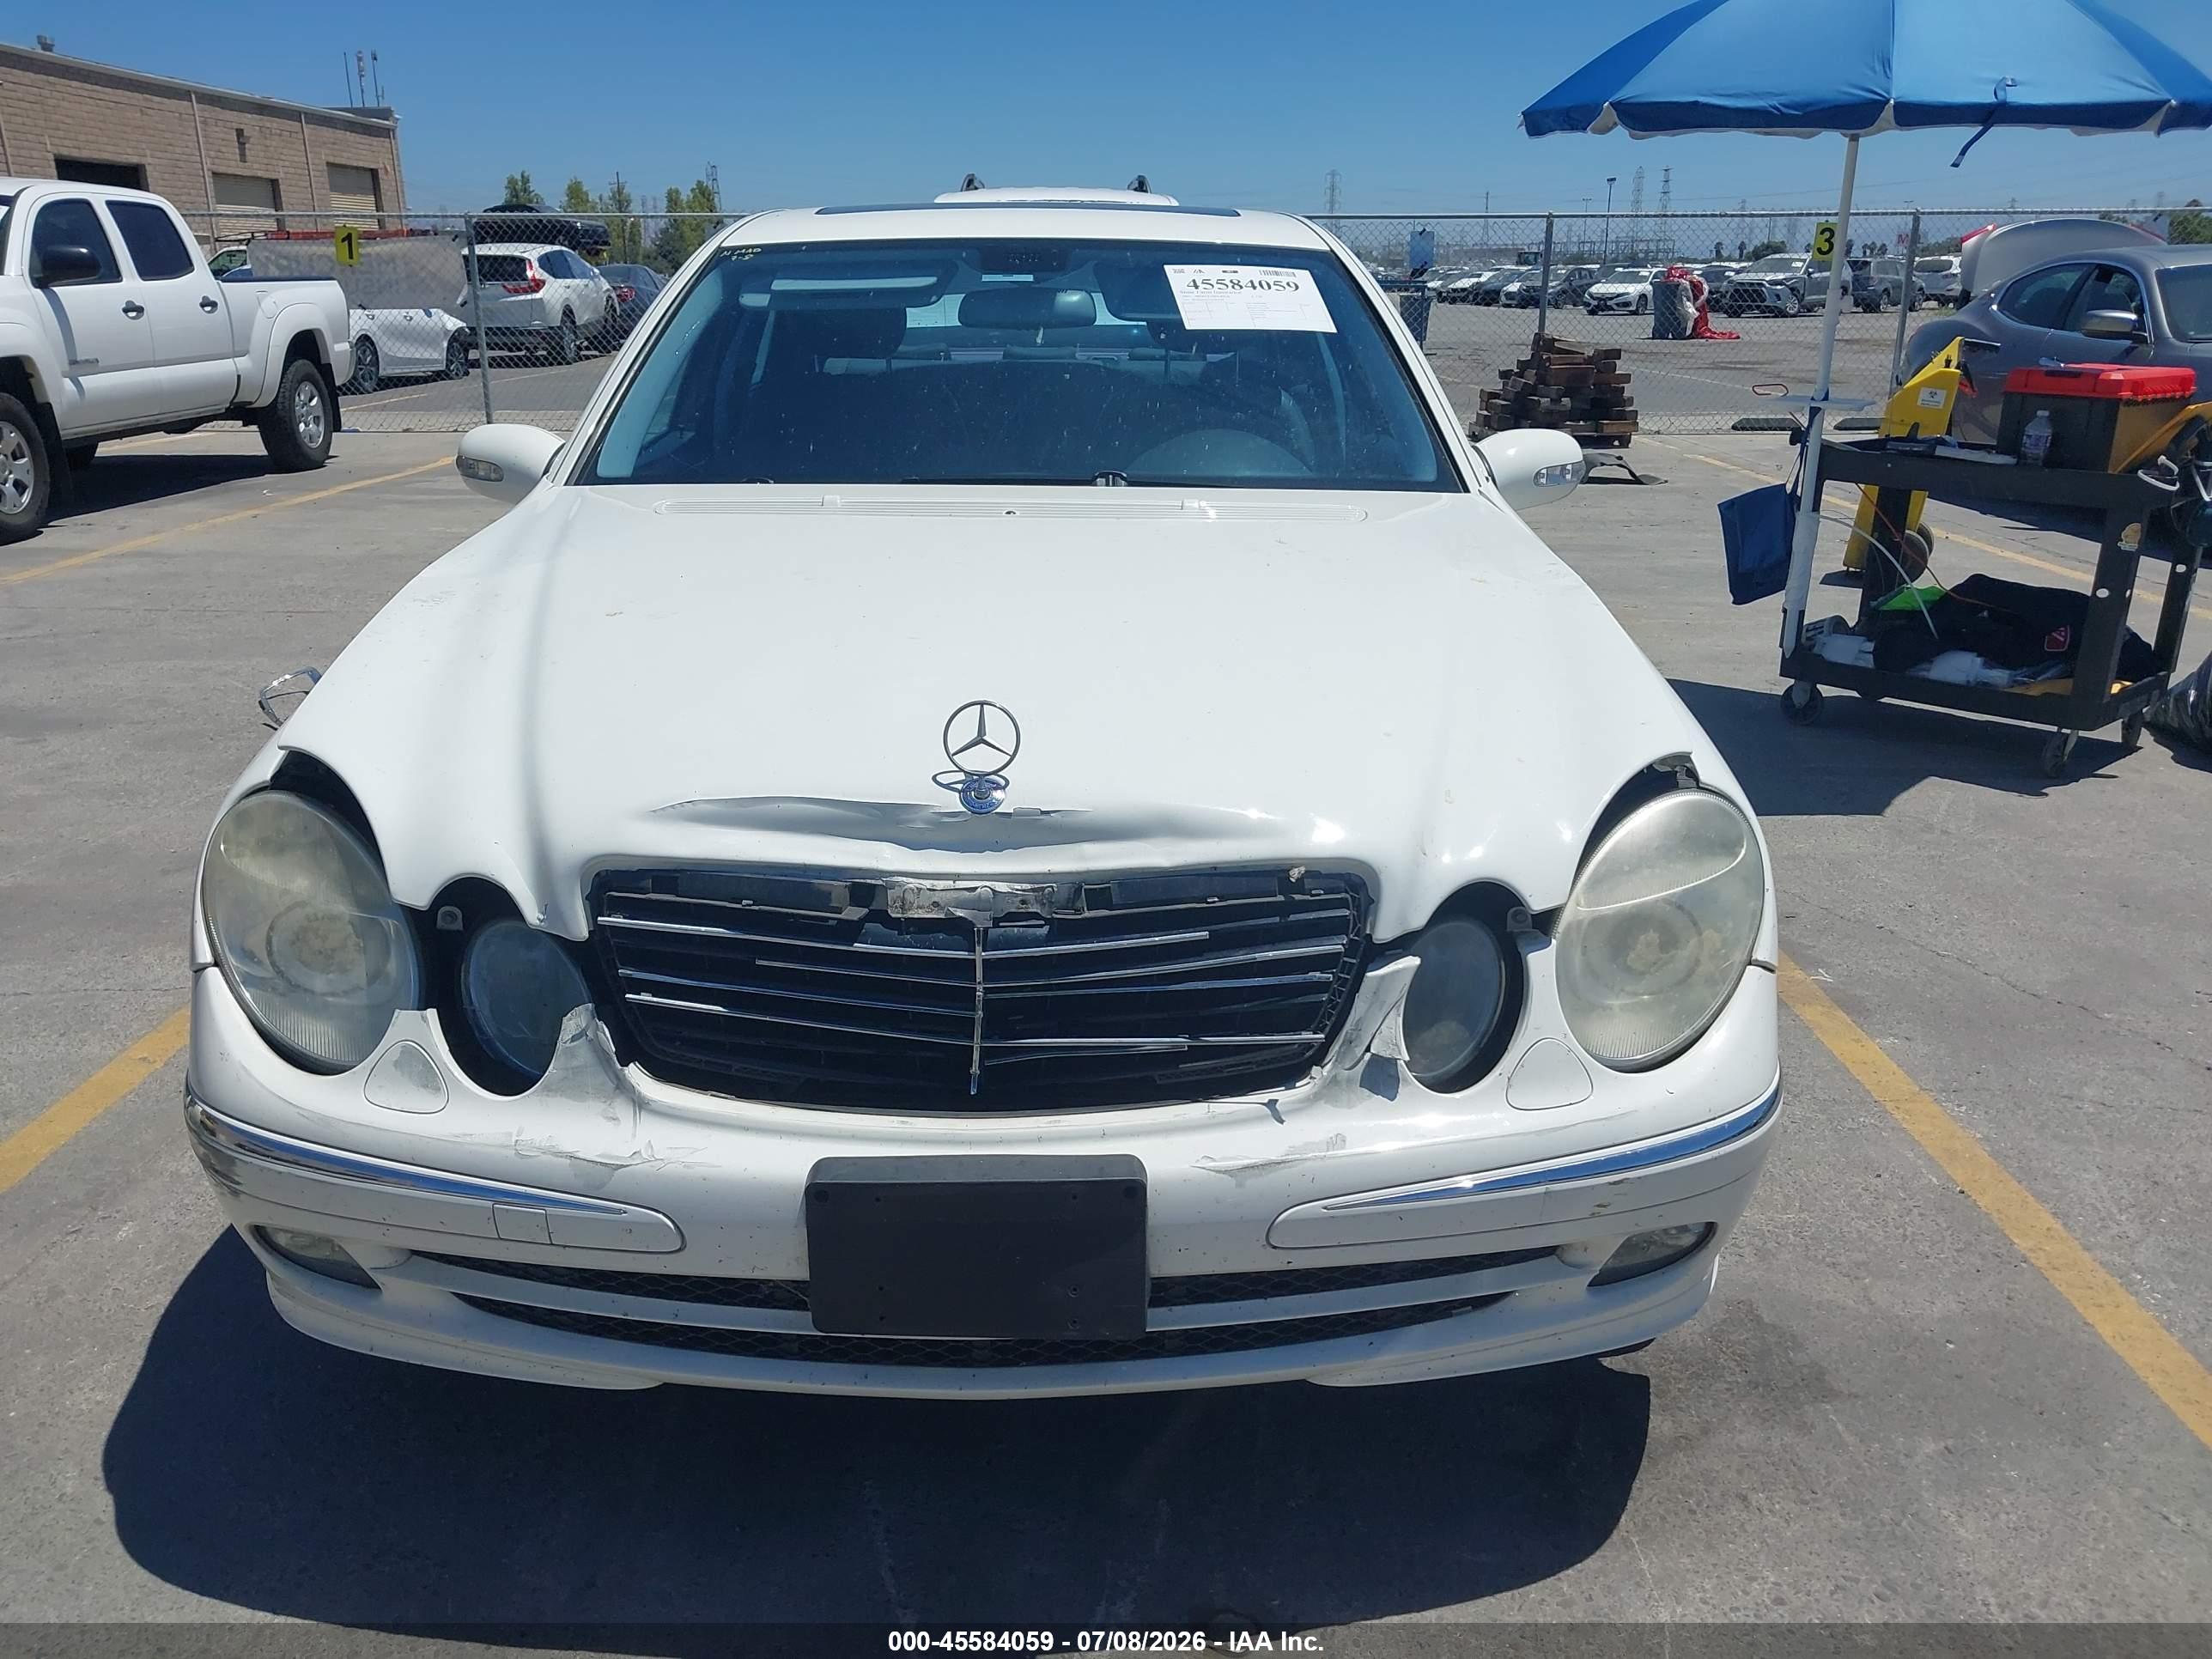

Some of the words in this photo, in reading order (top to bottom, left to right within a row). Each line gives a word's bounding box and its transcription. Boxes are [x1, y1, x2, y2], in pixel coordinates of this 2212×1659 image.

[341, 233, 354, 259] 1
[1816, 227, 1835, 255] 3
[1186, 278, 1300, 292] 45584059
